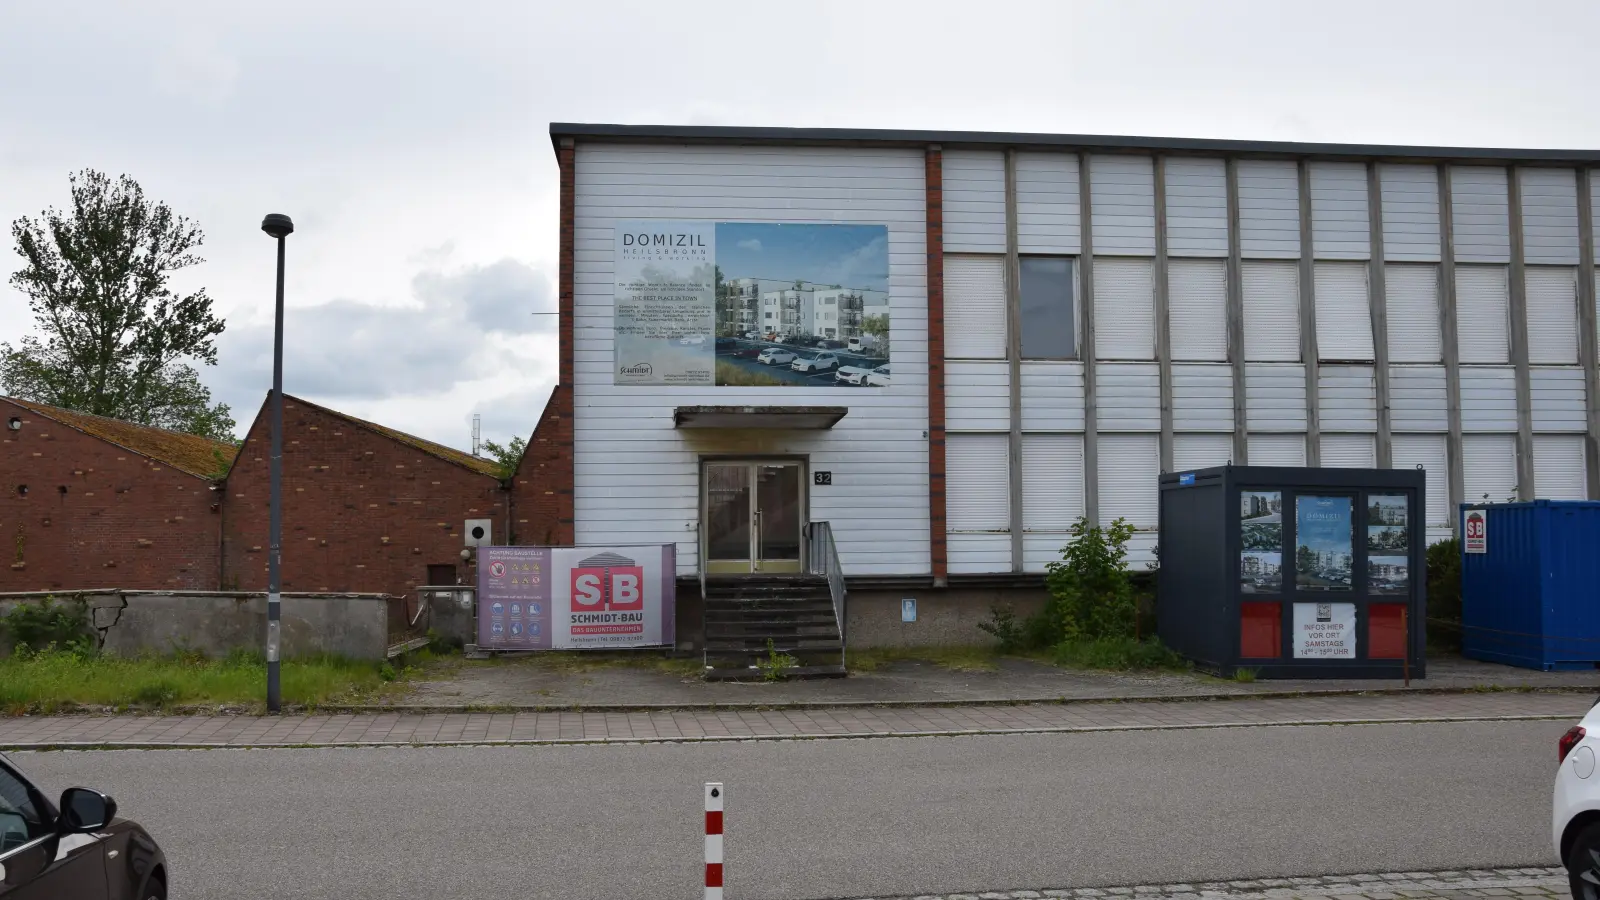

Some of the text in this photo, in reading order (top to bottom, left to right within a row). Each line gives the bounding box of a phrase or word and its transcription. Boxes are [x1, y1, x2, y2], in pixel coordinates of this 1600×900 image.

[623, 233, 706, 247] DOMIZIL
[816, 473, 831, 483] 32
[570, 613, 643, 624] SCHMIDT-BAU
